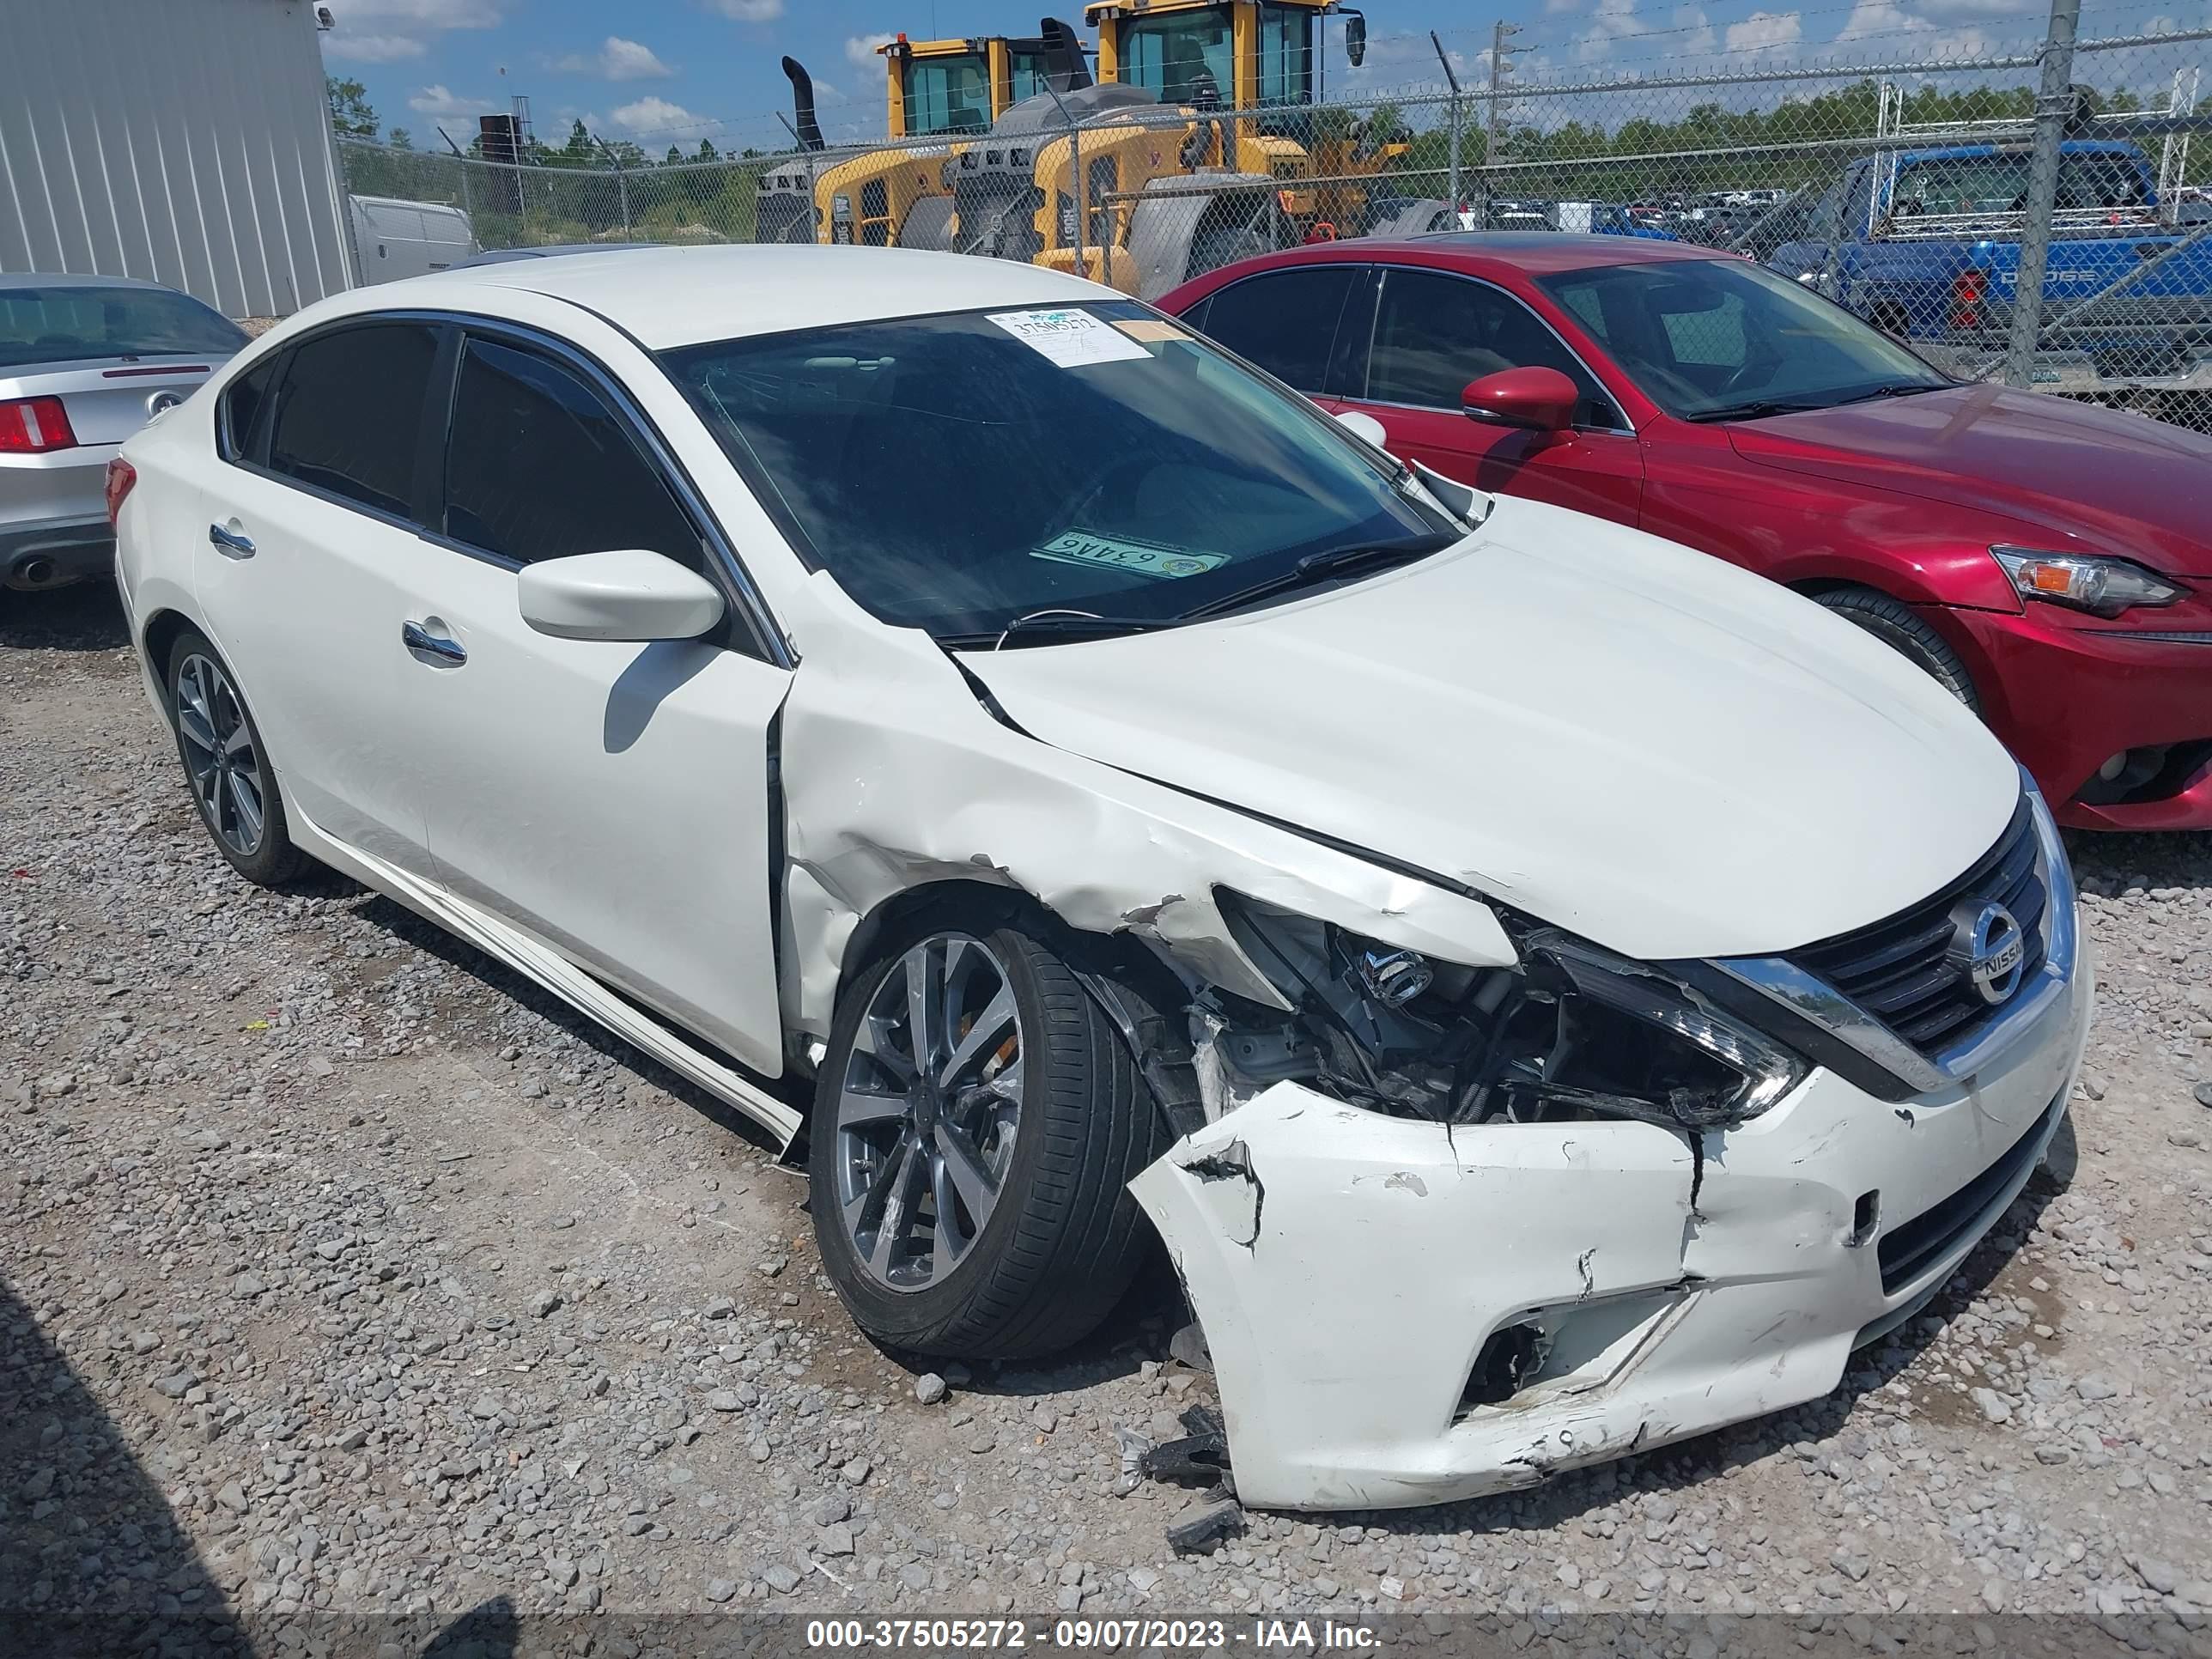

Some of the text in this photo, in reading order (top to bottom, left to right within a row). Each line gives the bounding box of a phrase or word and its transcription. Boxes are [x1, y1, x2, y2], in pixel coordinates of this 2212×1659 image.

[2001, 270, 2096, 283] DDGE
[1014, 319, 1098, 336] 37505272
[1054, 538, 1157, 564] 634A6
